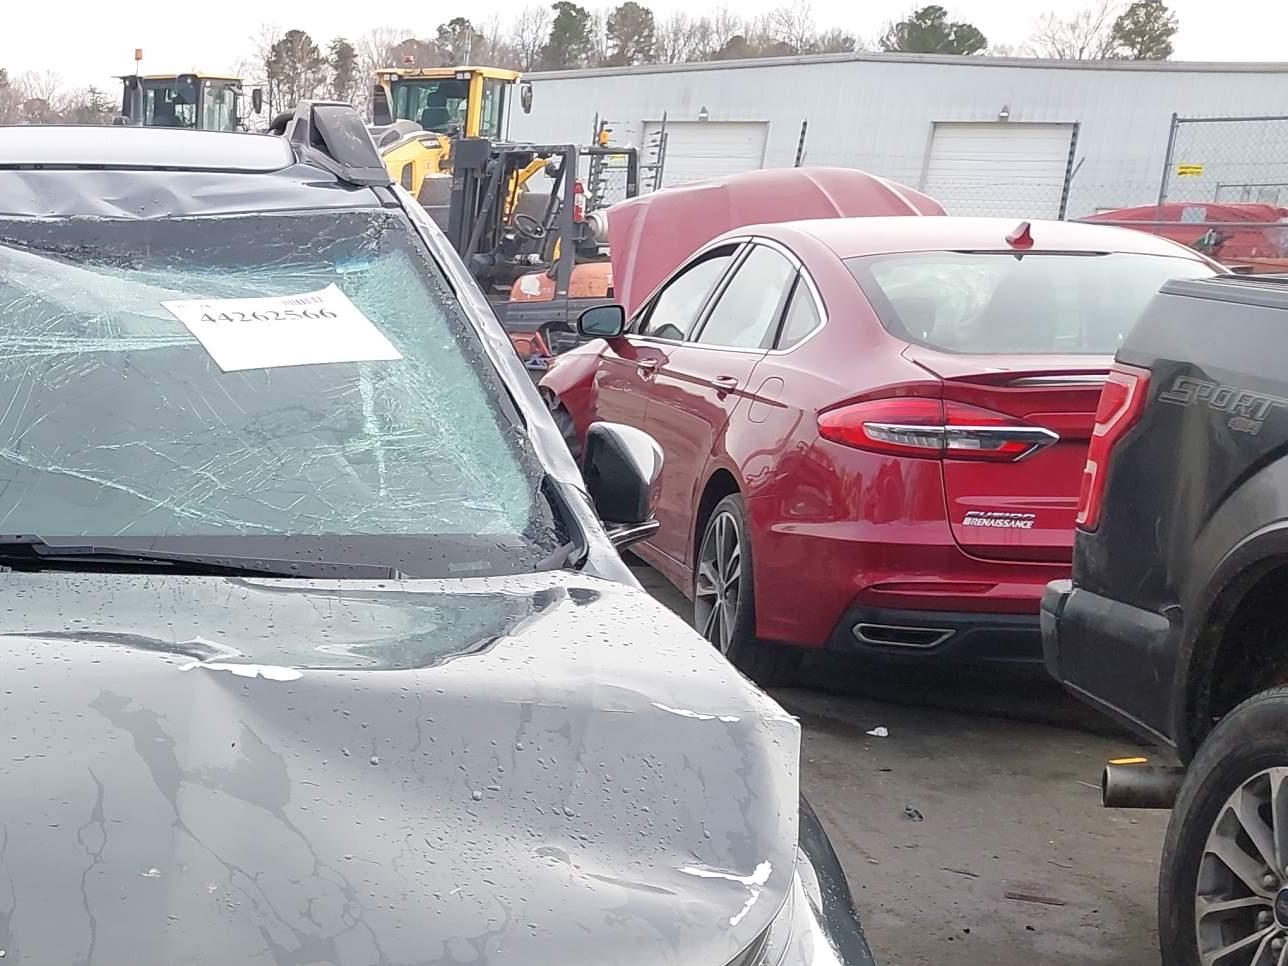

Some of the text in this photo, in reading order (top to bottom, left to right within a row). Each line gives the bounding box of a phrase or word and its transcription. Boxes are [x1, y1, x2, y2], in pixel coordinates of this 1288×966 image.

[200, 307, 338, 324] 44262566
[1159, 375, 1288, 421] SPORT
[971, 517, 1035, 529] RENAISSANCE
